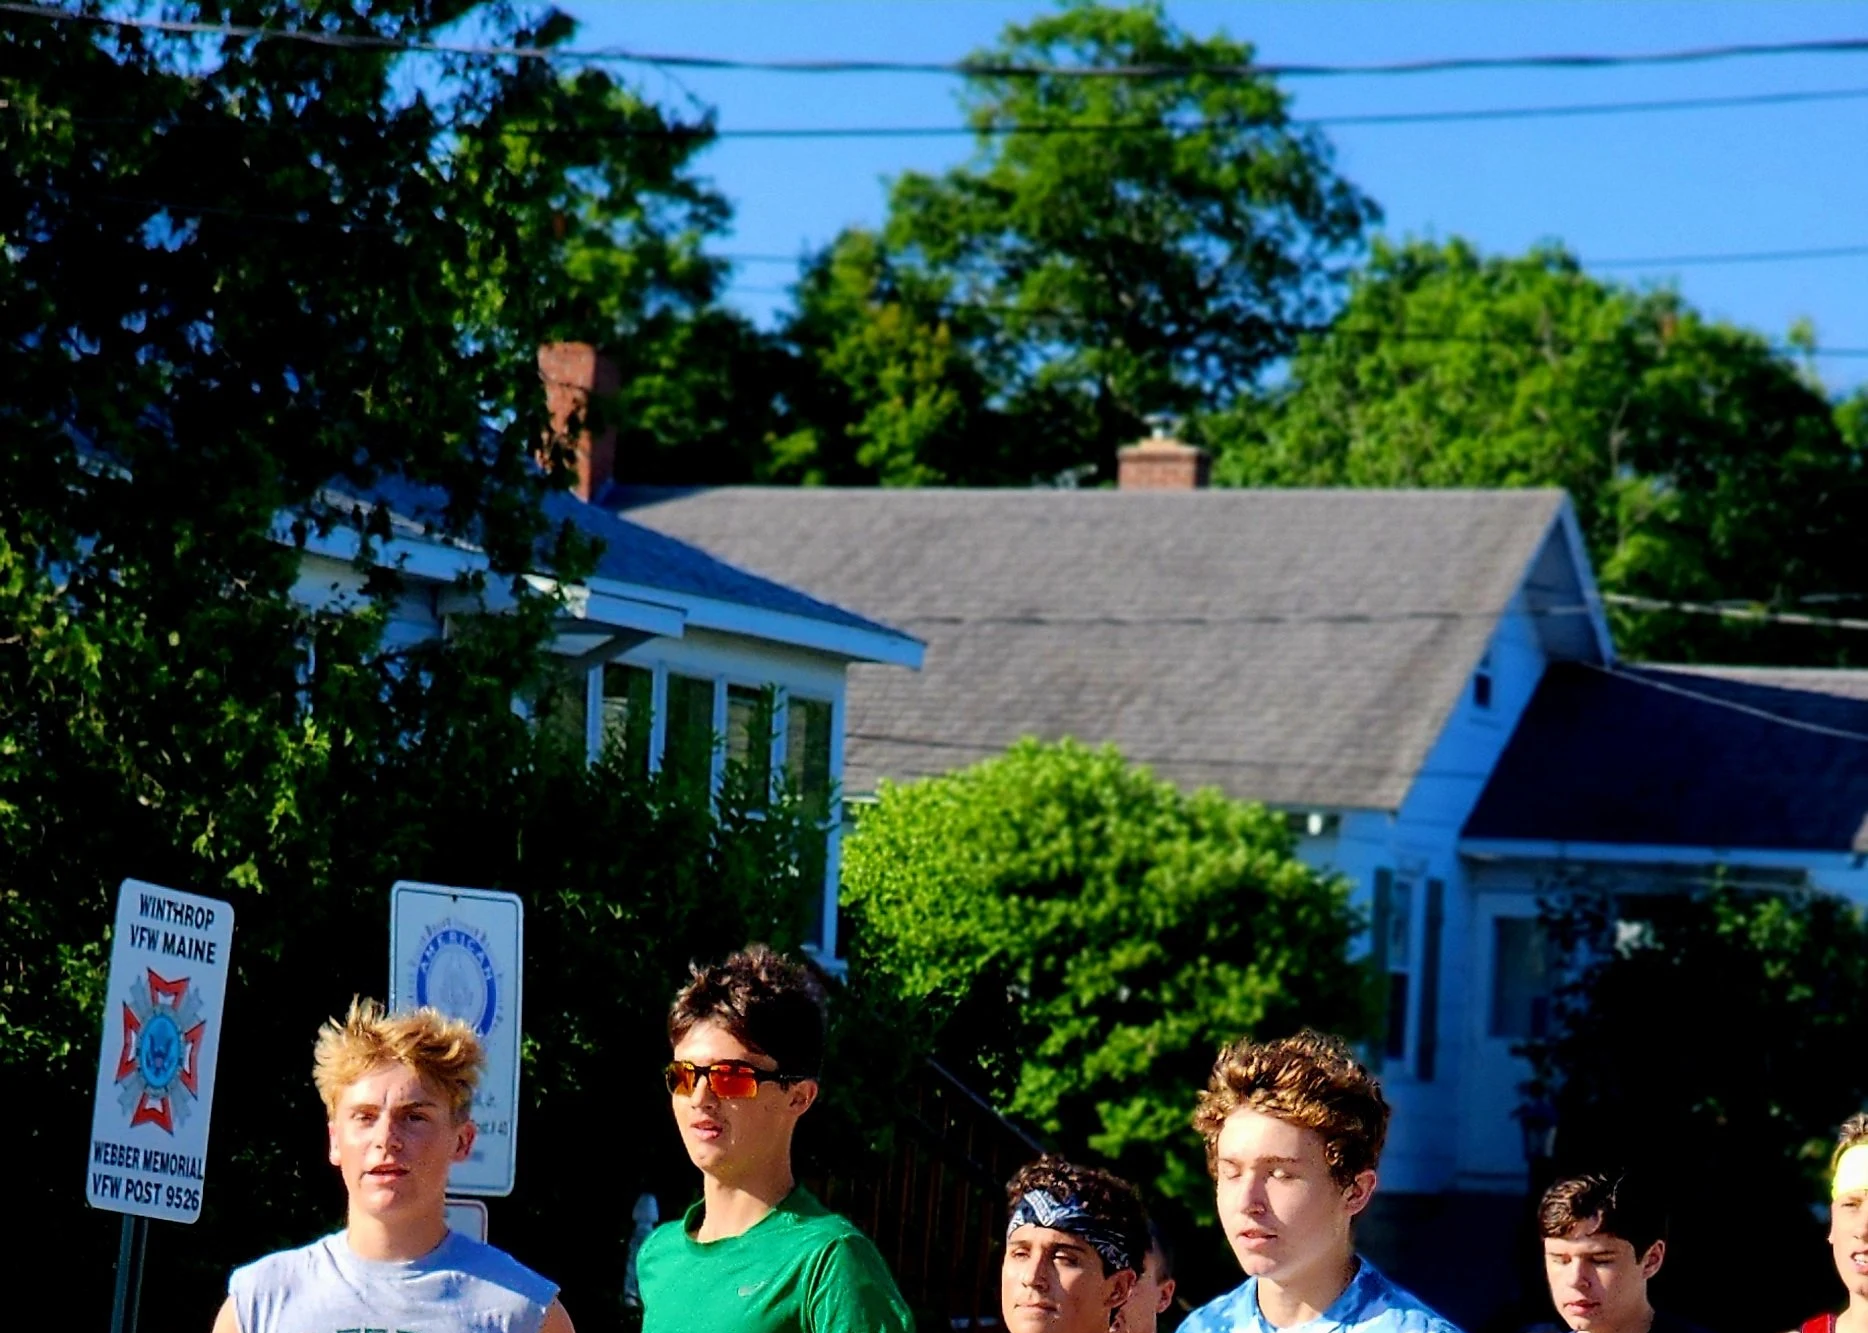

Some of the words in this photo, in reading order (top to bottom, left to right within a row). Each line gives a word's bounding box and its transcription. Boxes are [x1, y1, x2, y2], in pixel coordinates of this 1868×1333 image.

[139, 893, 215, 931] WINTHROP
[130, 923, 160, 952] VFW
[162, 930, 217, 964] MAINE
[420, 930, 494, 981] AMERICAN
[94, 1140, 140, 1170] WEBBER
[142, 1148, 204, 1180] MEMORIAL
[92, 1172, 122, 1199] VFW
[124, 1178, 163, 1206] POST
[166, 1185, 200, 1211] 9526
